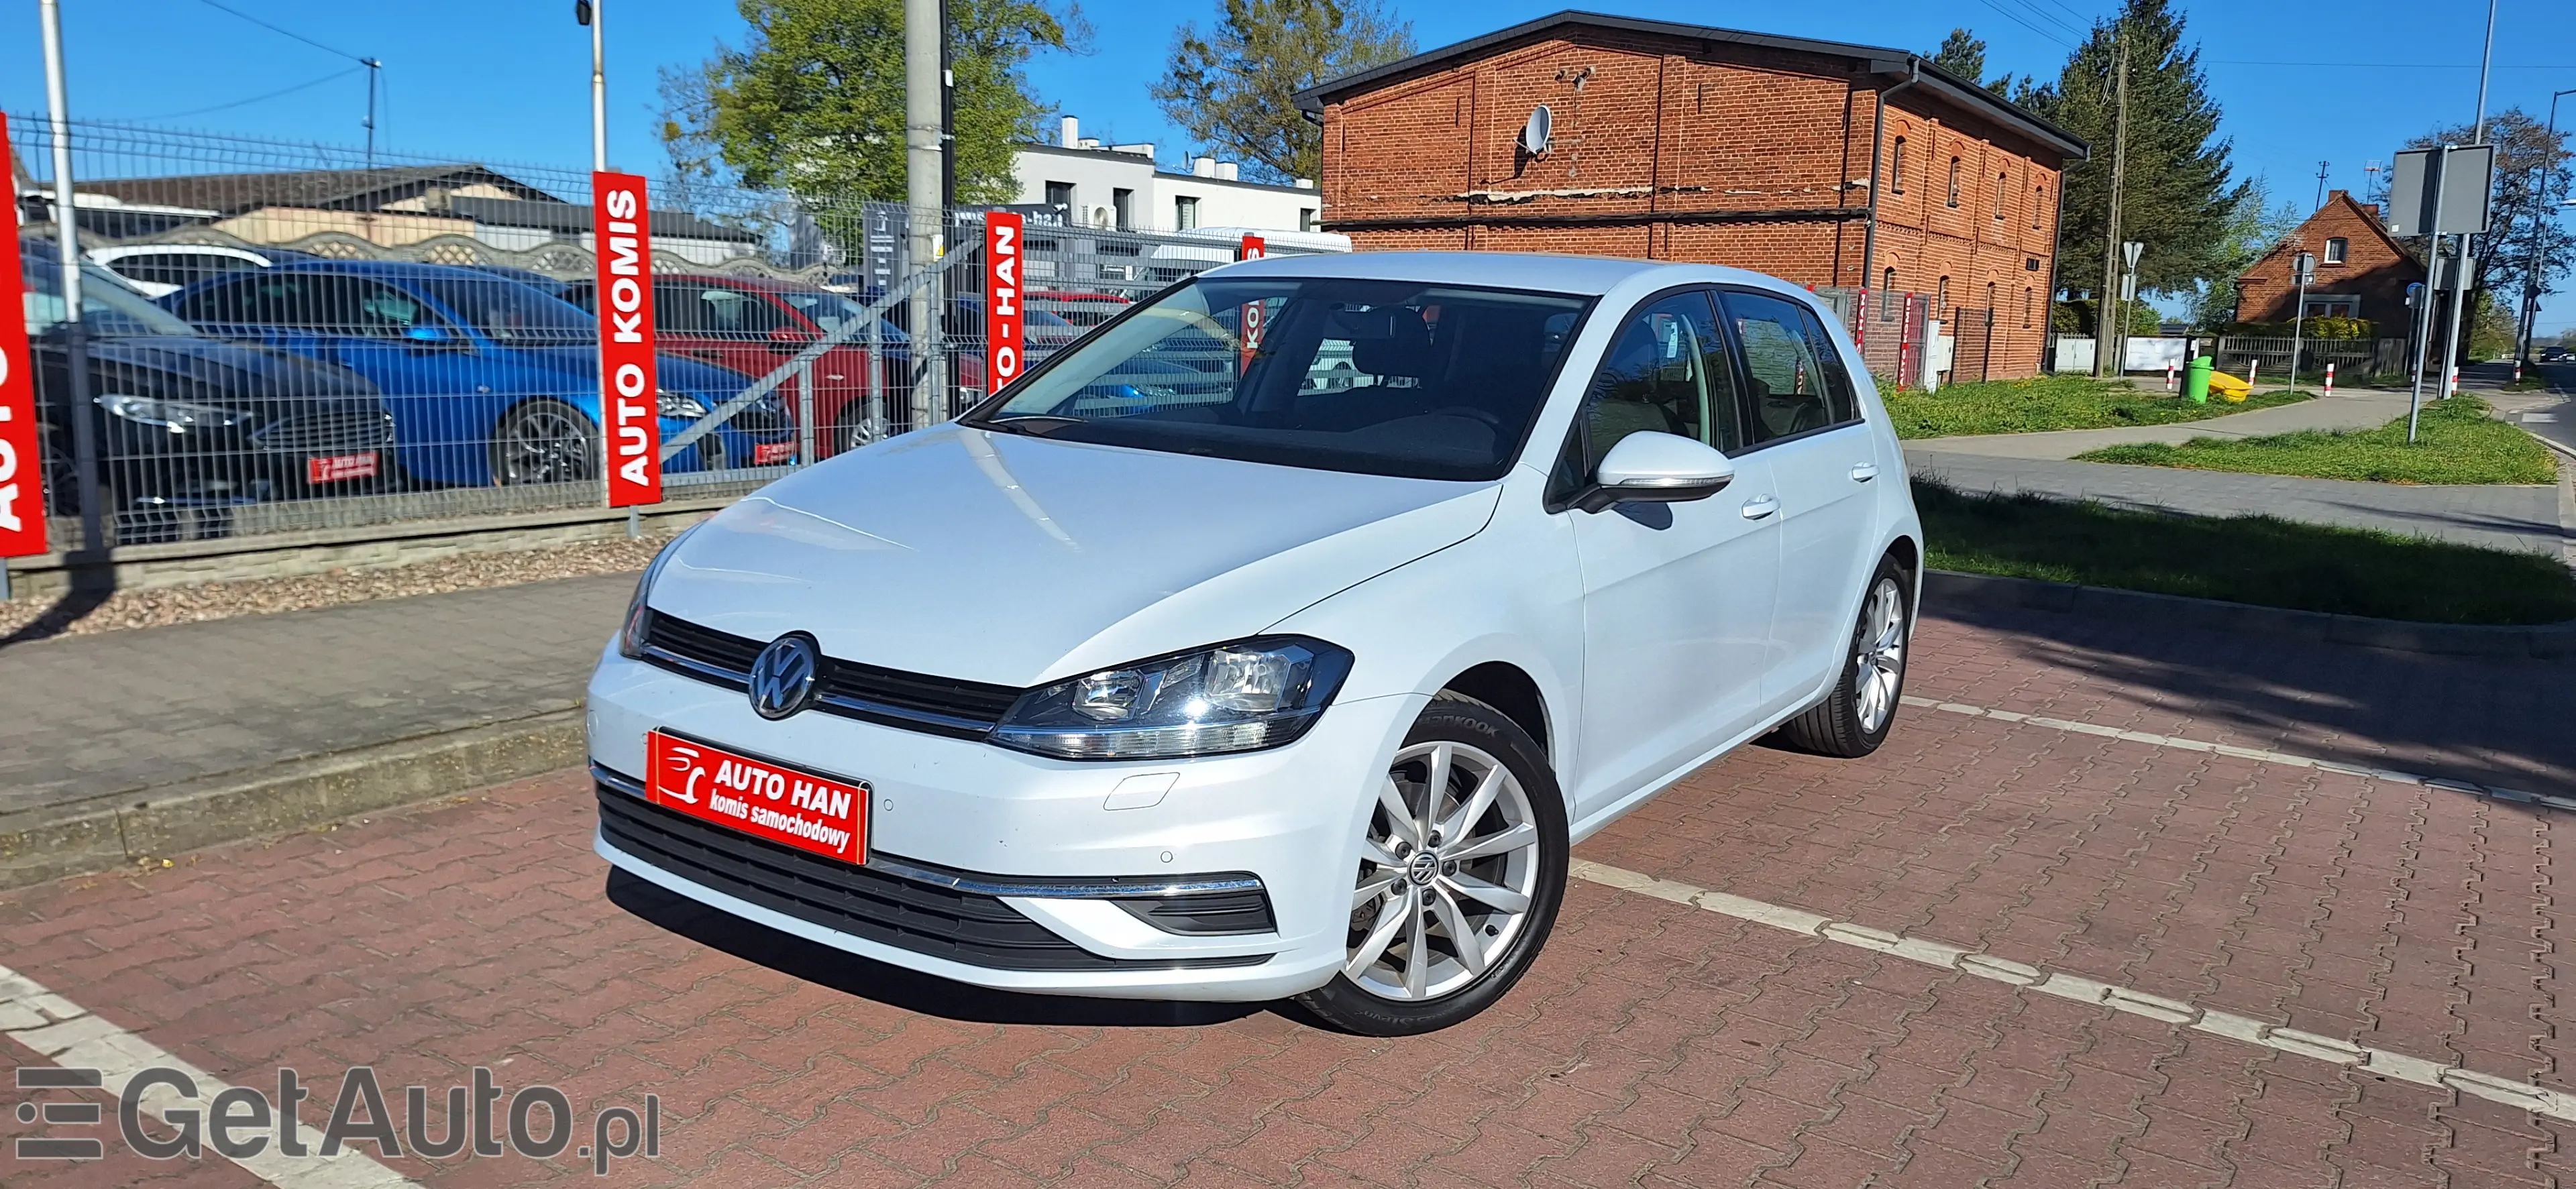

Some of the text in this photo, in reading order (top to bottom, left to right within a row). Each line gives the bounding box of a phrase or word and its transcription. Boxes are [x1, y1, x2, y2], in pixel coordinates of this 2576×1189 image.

[606, 189, 649, 487] AUTO KOMIS
[1903, 297, 1911, 343] KOMIS
[714, 759, 852, 819] AUTO HAN
[709, 790, 851, 854] komis samochodowy
